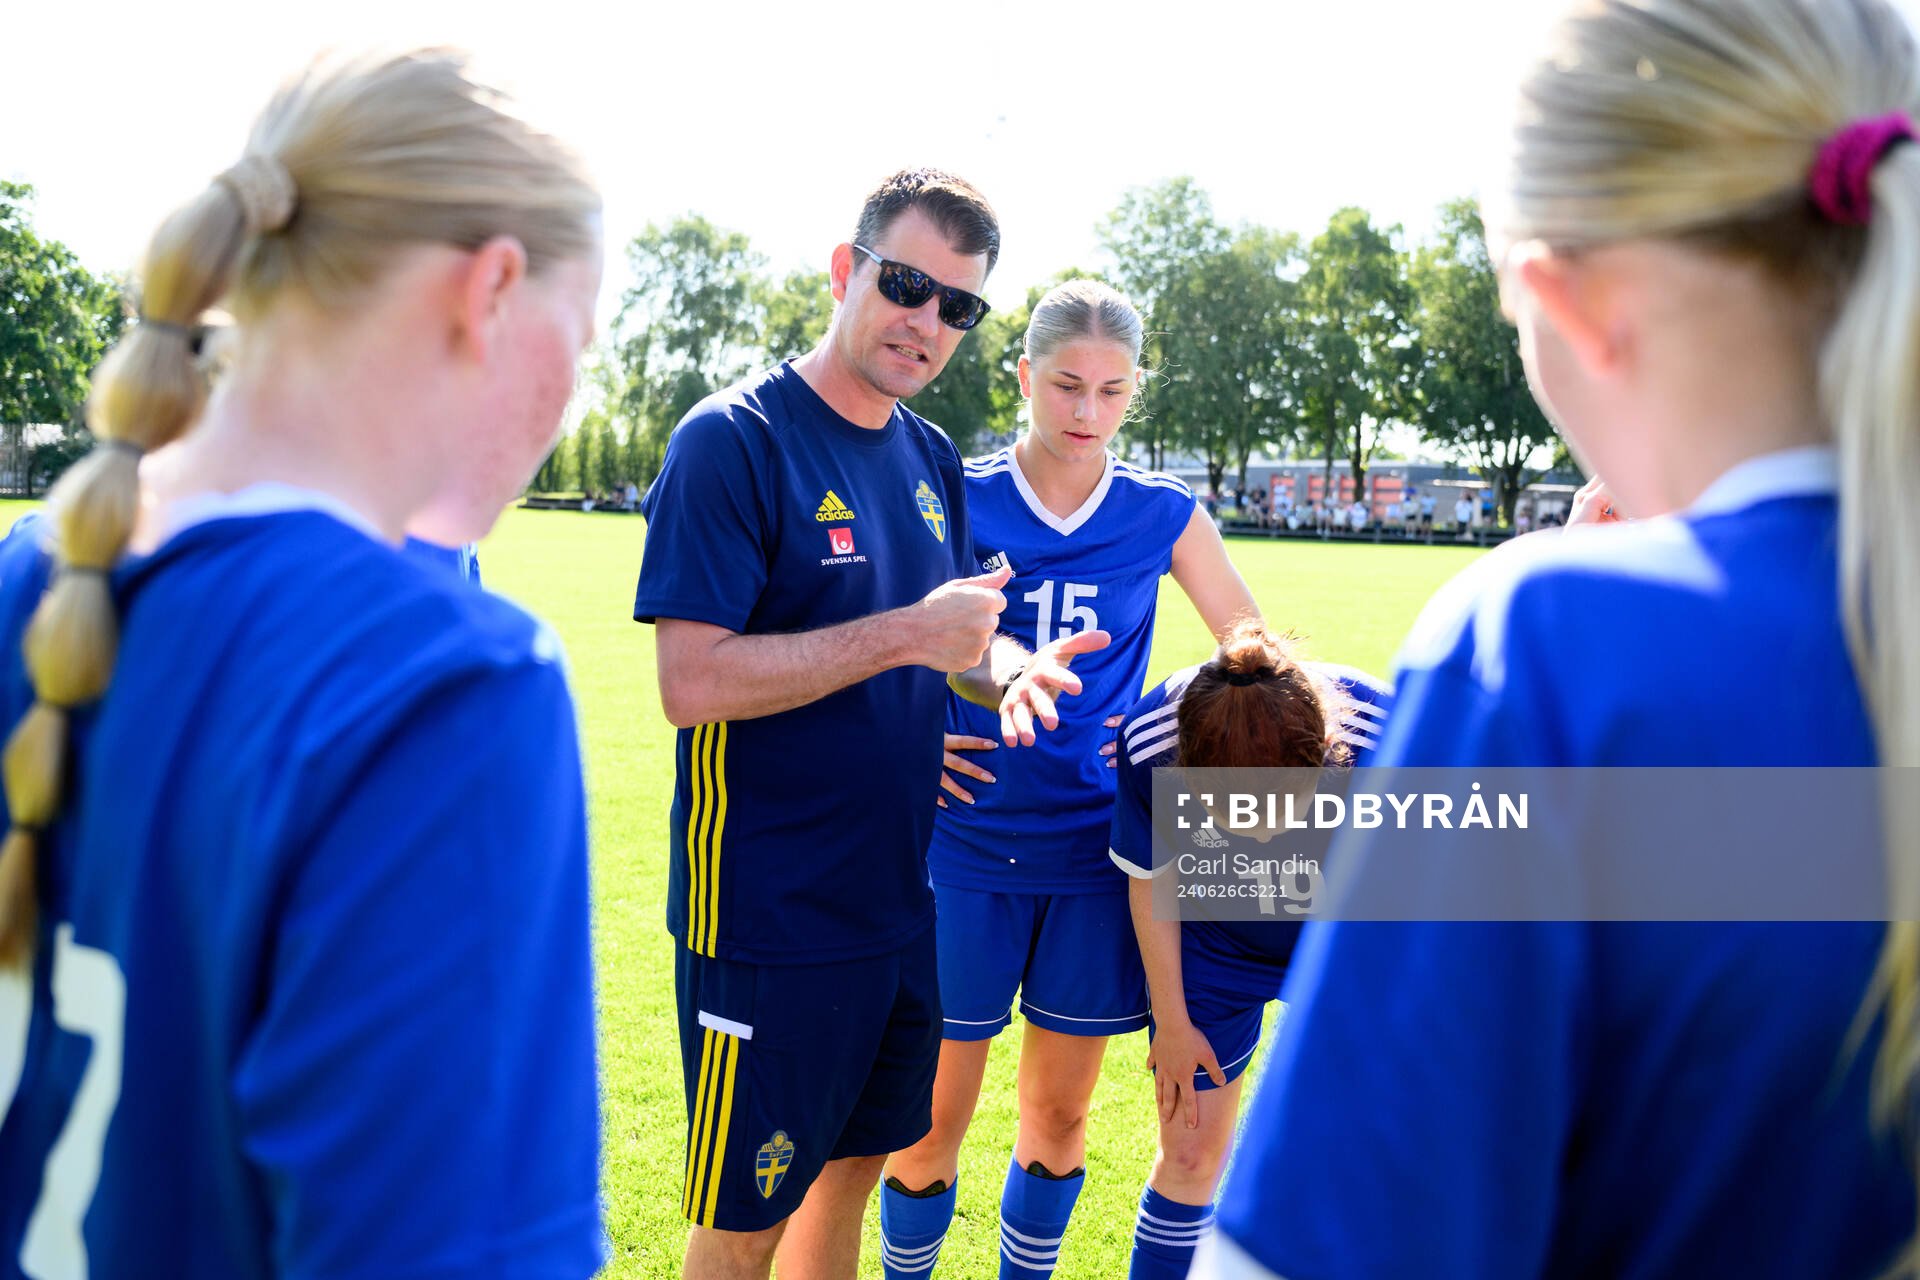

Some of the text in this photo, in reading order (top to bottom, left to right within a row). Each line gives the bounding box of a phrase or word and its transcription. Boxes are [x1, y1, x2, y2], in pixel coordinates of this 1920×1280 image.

[815, 510, 855, 522] adidas
[821, 555, 867, 566] SVENSKA SPEL
[1024, 580, 1098, 650] 15
